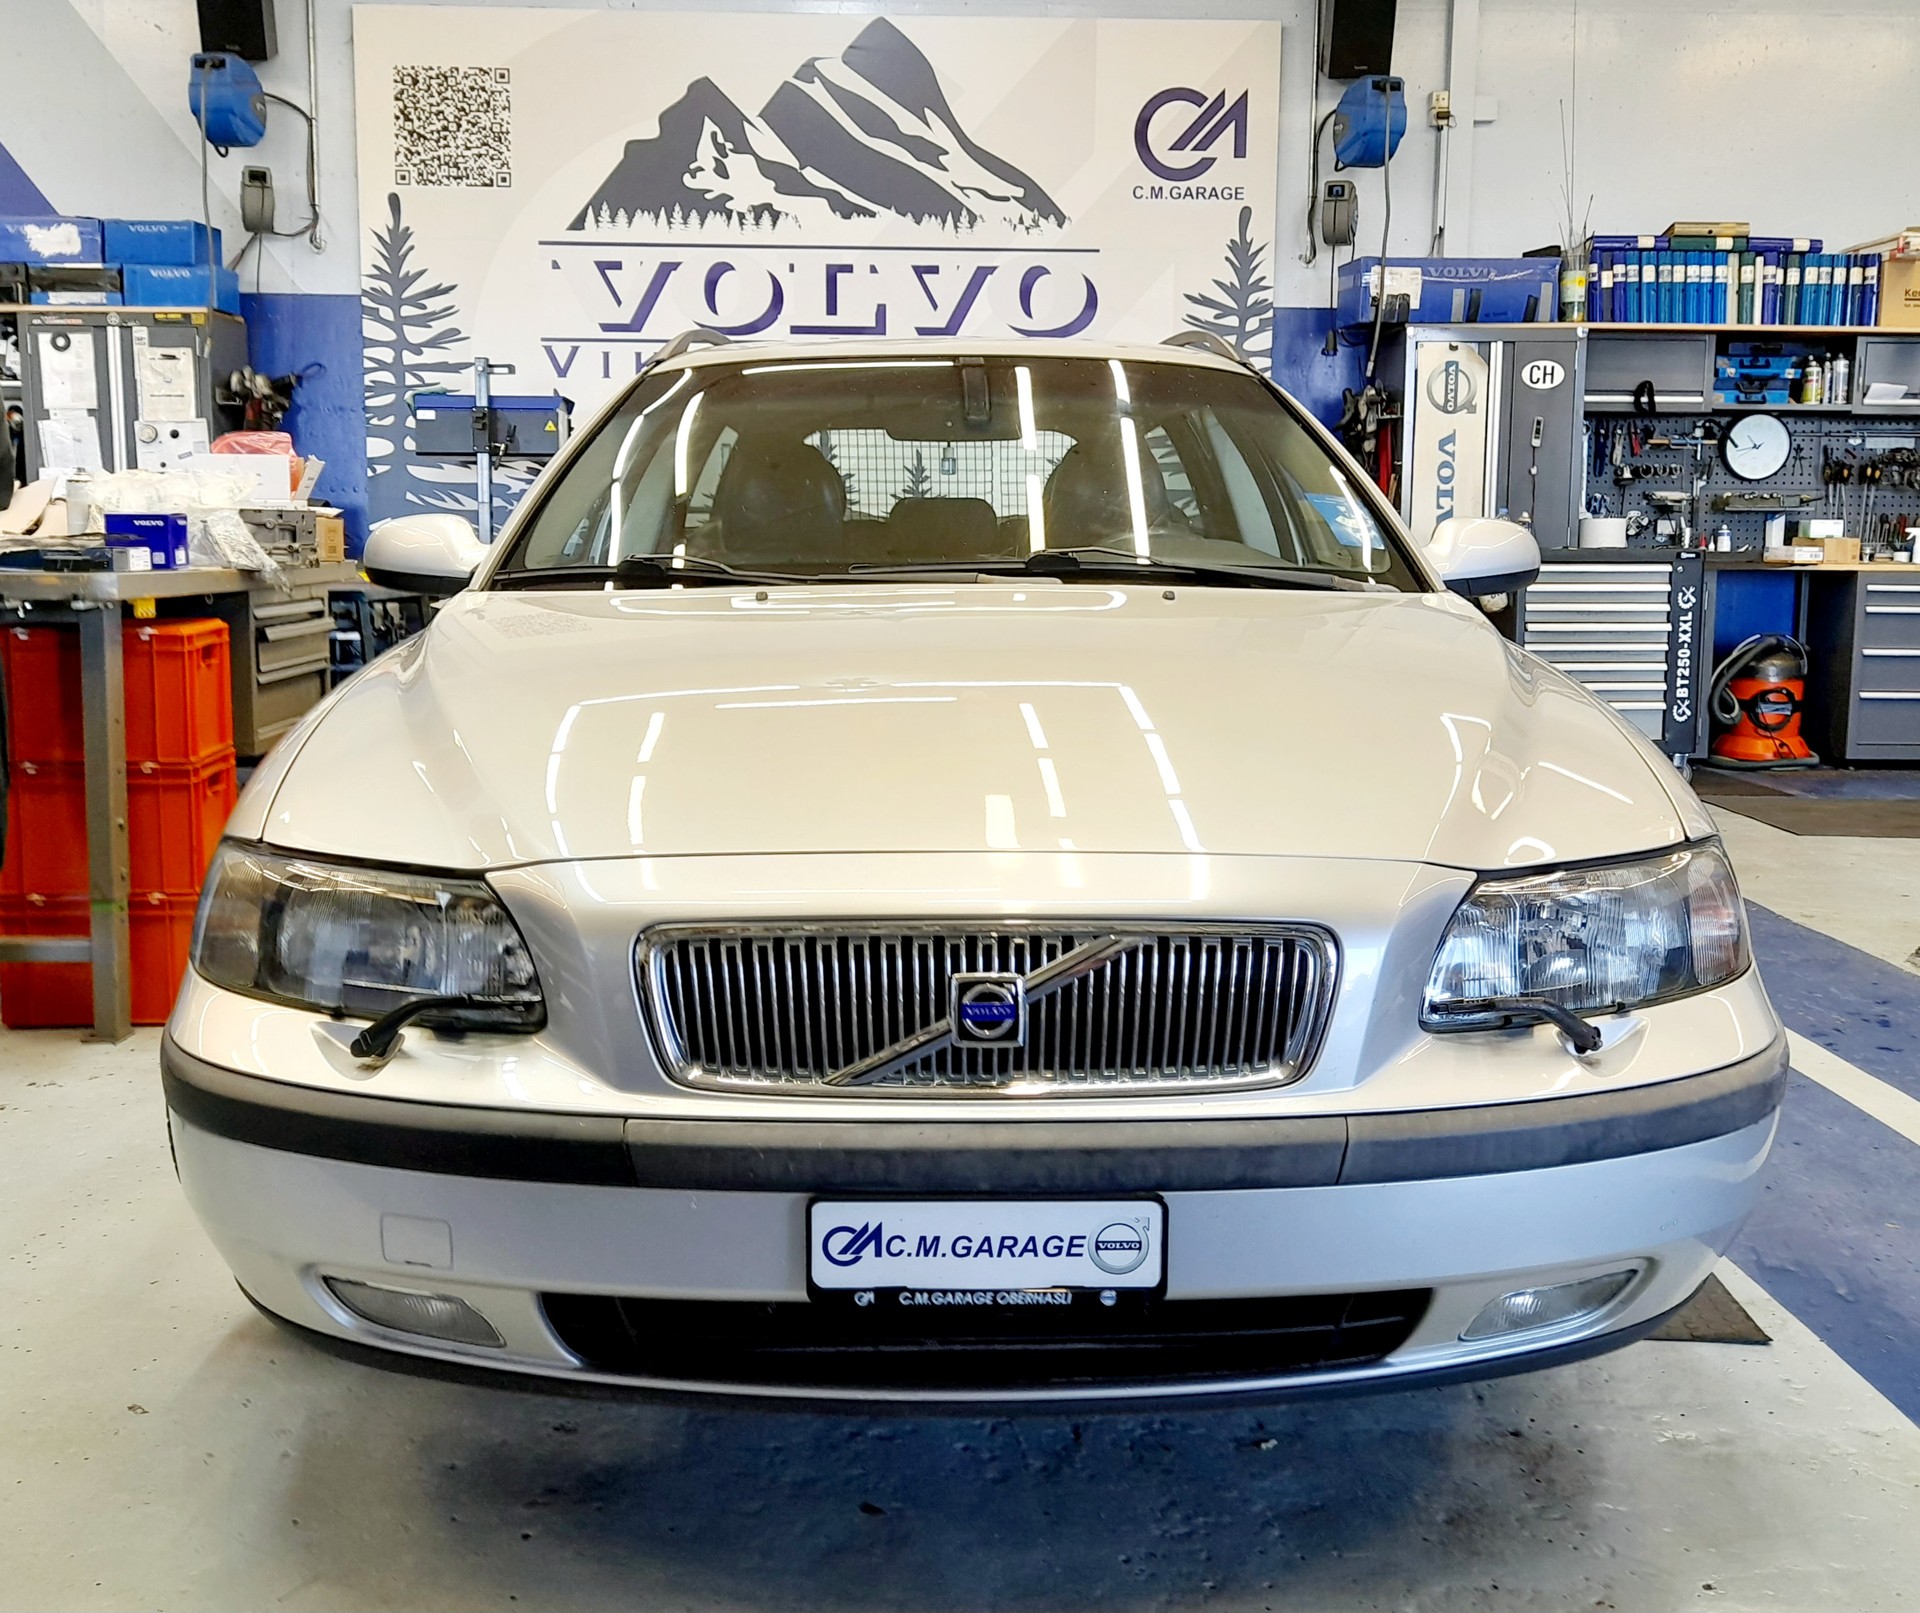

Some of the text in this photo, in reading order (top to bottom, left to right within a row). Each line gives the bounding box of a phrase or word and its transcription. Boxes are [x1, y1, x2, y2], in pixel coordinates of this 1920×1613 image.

[1132, 185, 1245, 201] C.M.GARAGE
[128, 224, 168, 233] VOLVO
[548, 258, 1099, 337] VOLVO
[1529, 364, 1555, 385] CH
[1447, 365, 1457, 413] VOLVO
[133, 519, 165, 527] VOLVO
[1676, 611, 1693, 698] BT250-XXL
[885, 1234, 1087, 1259] C.M.GARAGE
[1097, 1241, 1141, 1250] VOLVO
